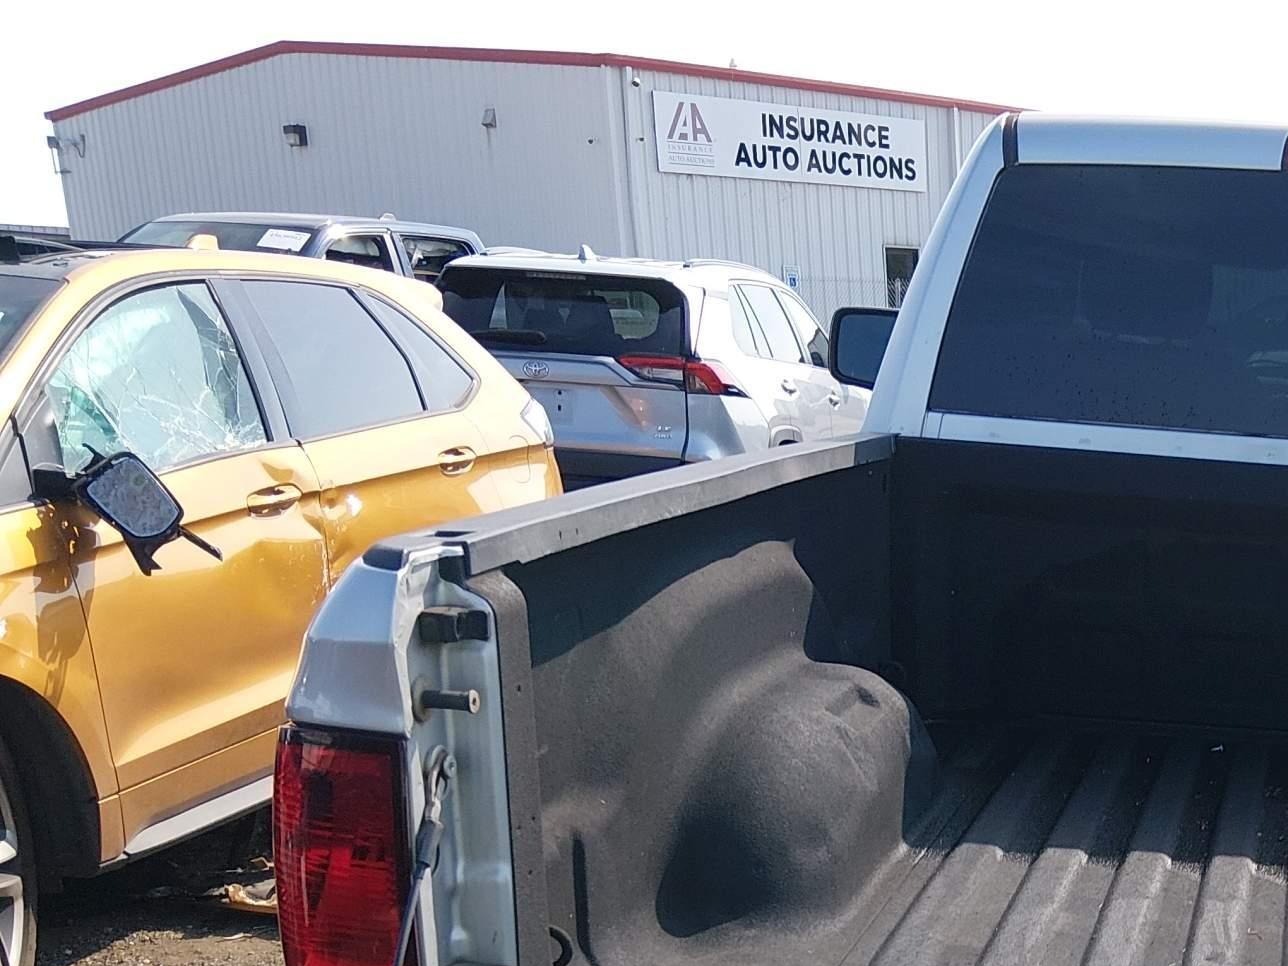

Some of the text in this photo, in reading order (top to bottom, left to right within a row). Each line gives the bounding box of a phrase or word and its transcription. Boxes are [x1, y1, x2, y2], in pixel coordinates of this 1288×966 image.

[761, 113, 890, 149] INSURANCE
[735, 143, 917, 181] AUTO AUCTIONS
